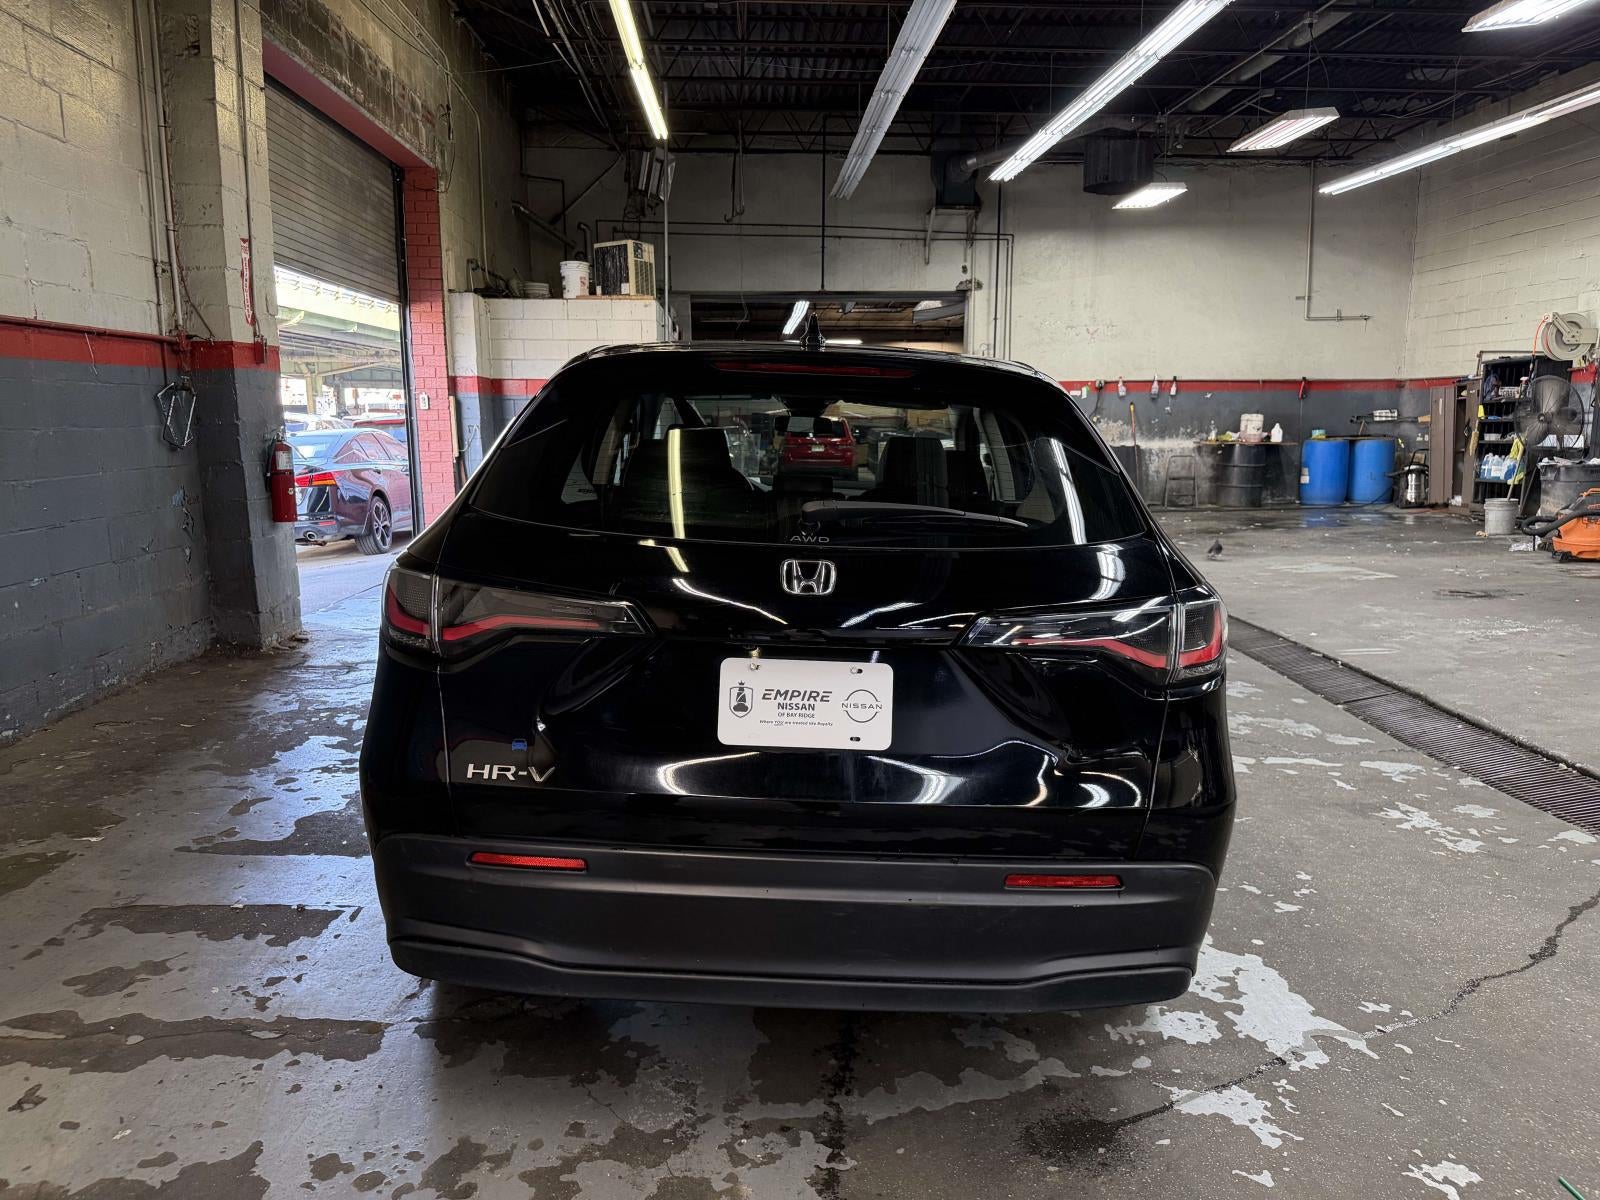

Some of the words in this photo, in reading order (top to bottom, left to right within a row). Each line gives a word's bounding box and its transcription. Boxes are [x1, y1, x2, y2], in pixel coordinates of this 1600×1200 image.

[790, 535, 830, 543] AWD
[761, 688, 833, 703] EMPIRE
[777, 702, 816, 711] NISSAN
[841, 702, 883, 710] NISSAN
[466, 763, 555, 782] HR-V
